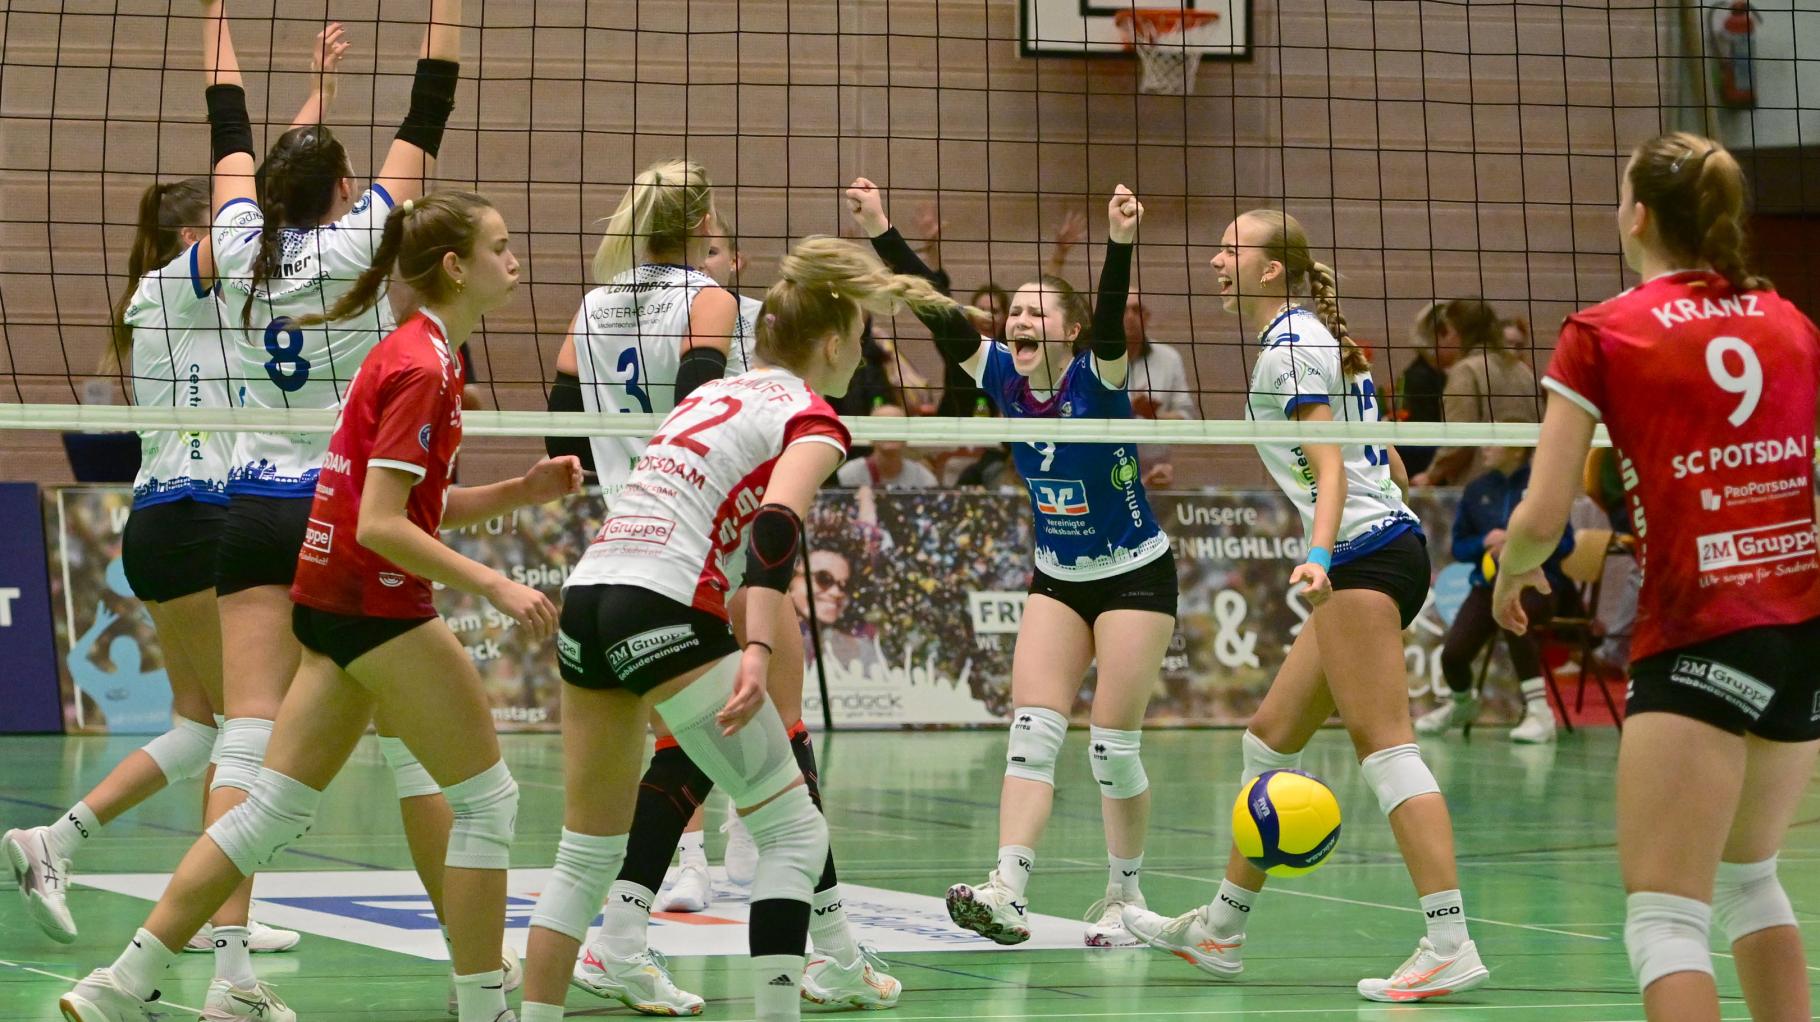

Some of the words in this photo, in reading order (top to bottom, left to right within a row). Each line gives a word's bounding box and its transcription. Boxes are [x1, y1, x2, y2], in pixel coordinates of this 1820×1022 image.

[1650, 294, 1766, 329] KRANZ
[263, 315, 312, 393] 8
[1705, 336, 1764, 428] 9
[648, 394, 743, 459] 22
[1671, 450, 1705, 479] SC
[1709, 434, 1808, 471] POTSDA
[637, 455, 706, 490] OTSDAM
[1176, 502, 1258, 526] Unsere
[609, 521, 667, 537] Gruppe
[1703, 540, 1732, 561] 2M
[608, 648, 630, 667] 2M
[1679, 660, 1708, 677] 2M
[1711, 669, 1768, 705] Gruppe
[68, 812, 90, 839] VCO
[620, 894, 652, 913] VC
[1220, 893, 1251, 913] VCO
[1425, 906, 1460, 919] VCO
